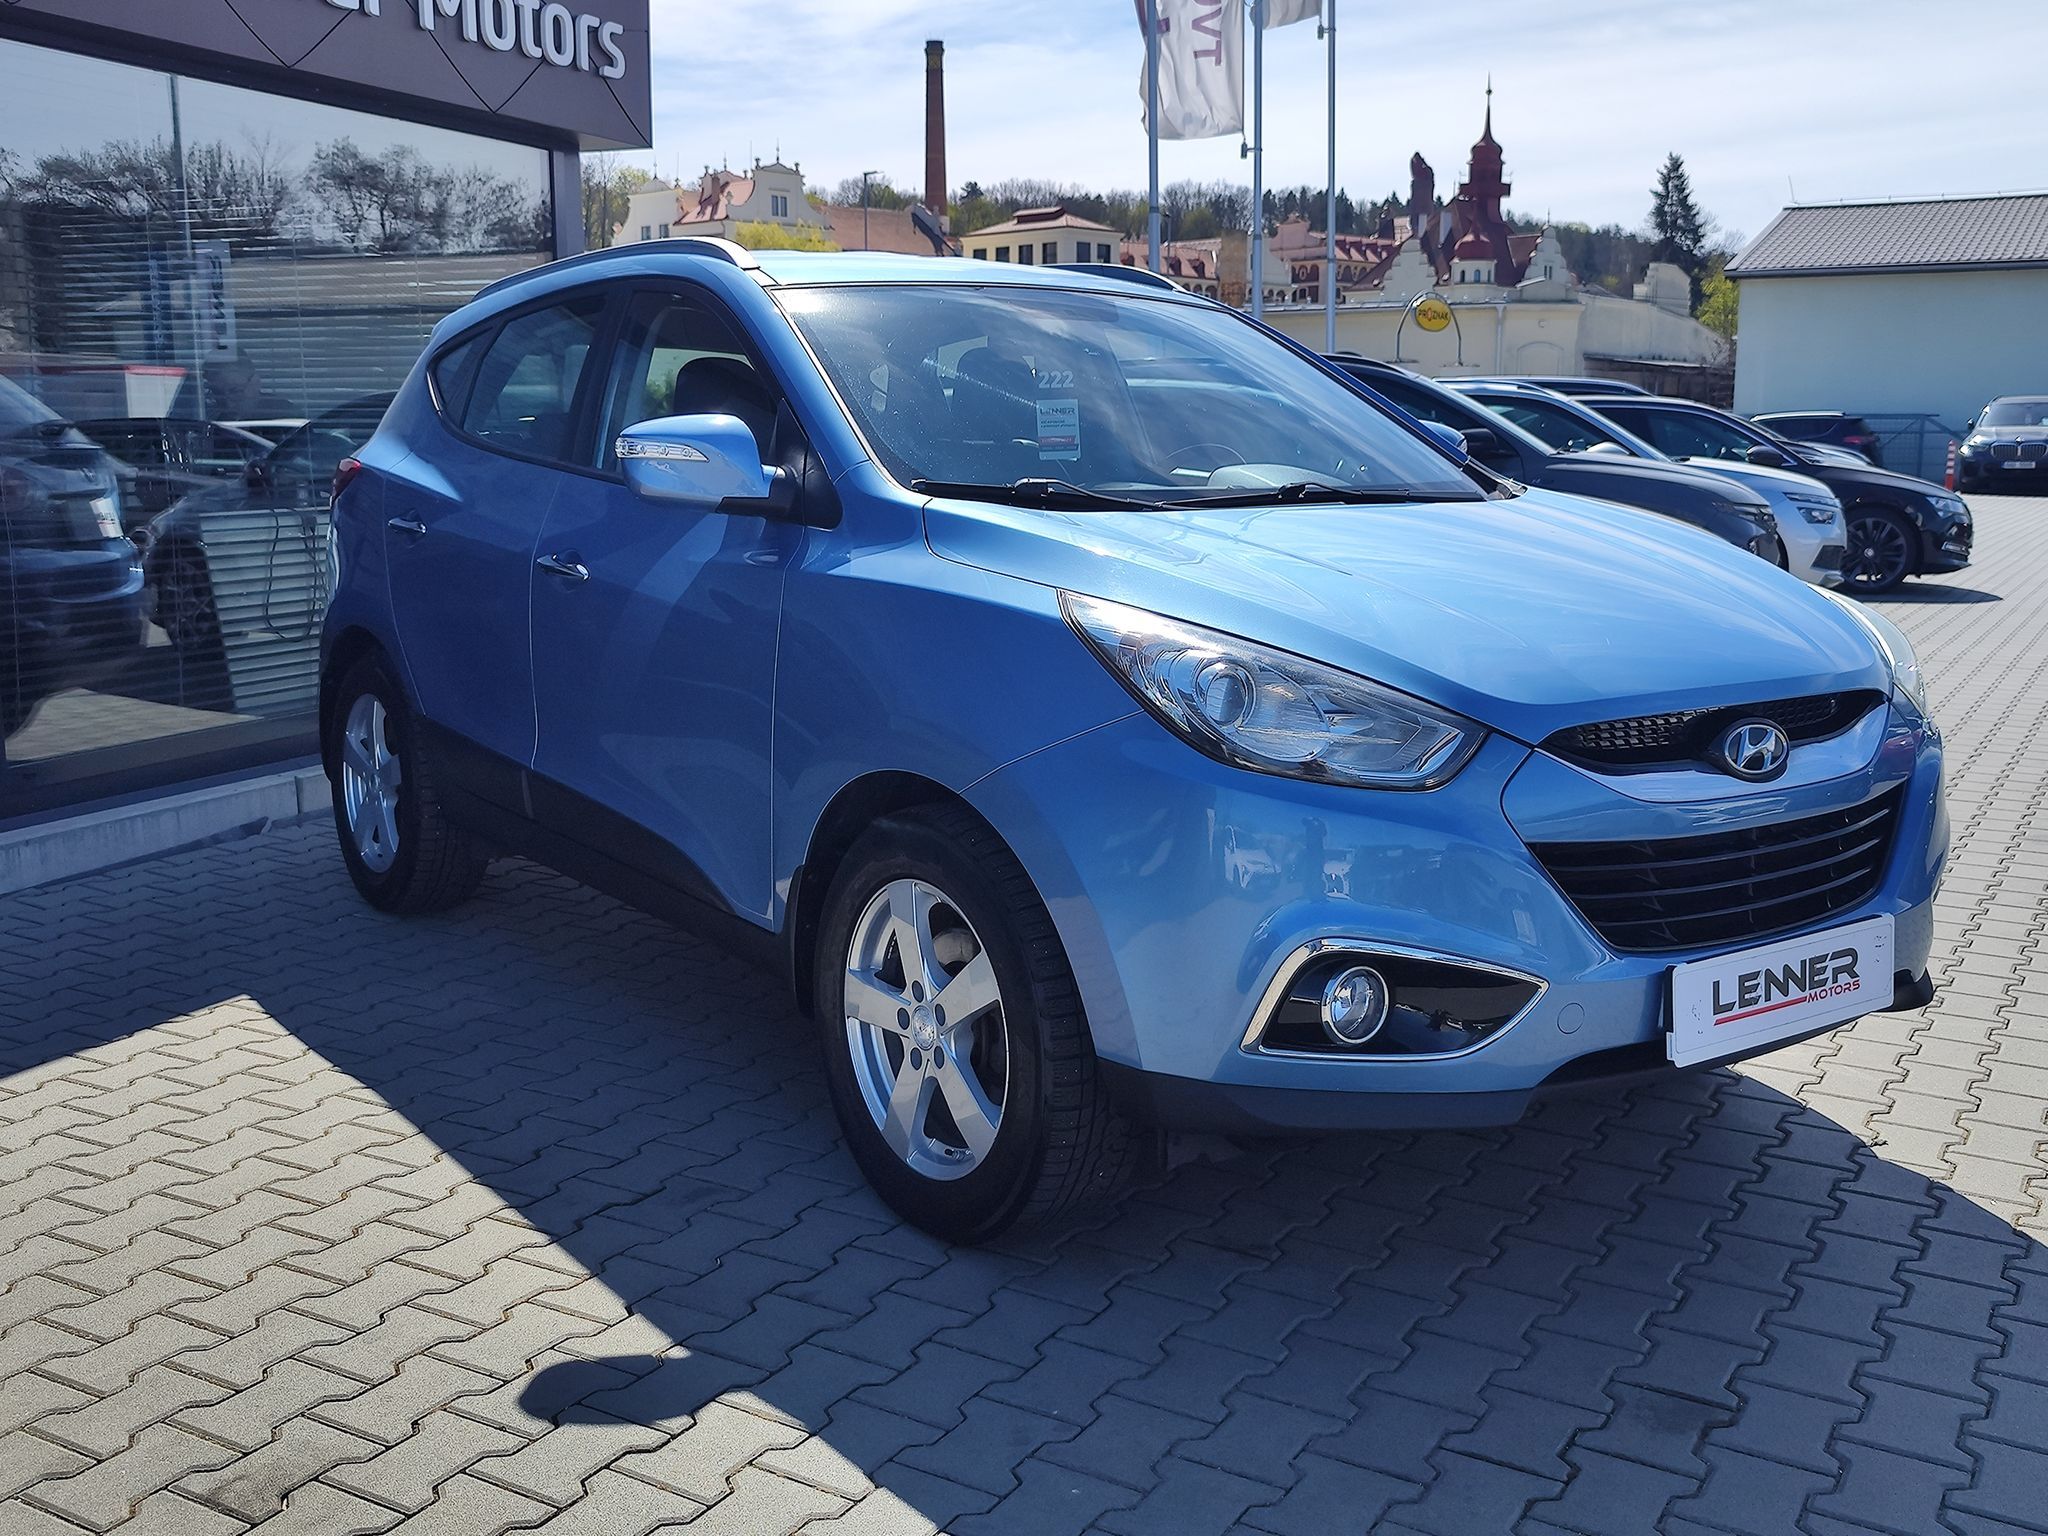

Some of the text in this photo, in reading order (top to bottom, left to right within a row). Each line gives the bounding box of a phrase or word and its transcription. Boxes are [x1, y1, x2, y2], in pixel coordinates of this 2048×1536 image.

[1191, 0, 1222, 66] VT
[1038, 370, 1074, 389] 222
[1712, 947, 1861, 1016] LENNER
[1806, 978, 1861, 1004] MOTORS
